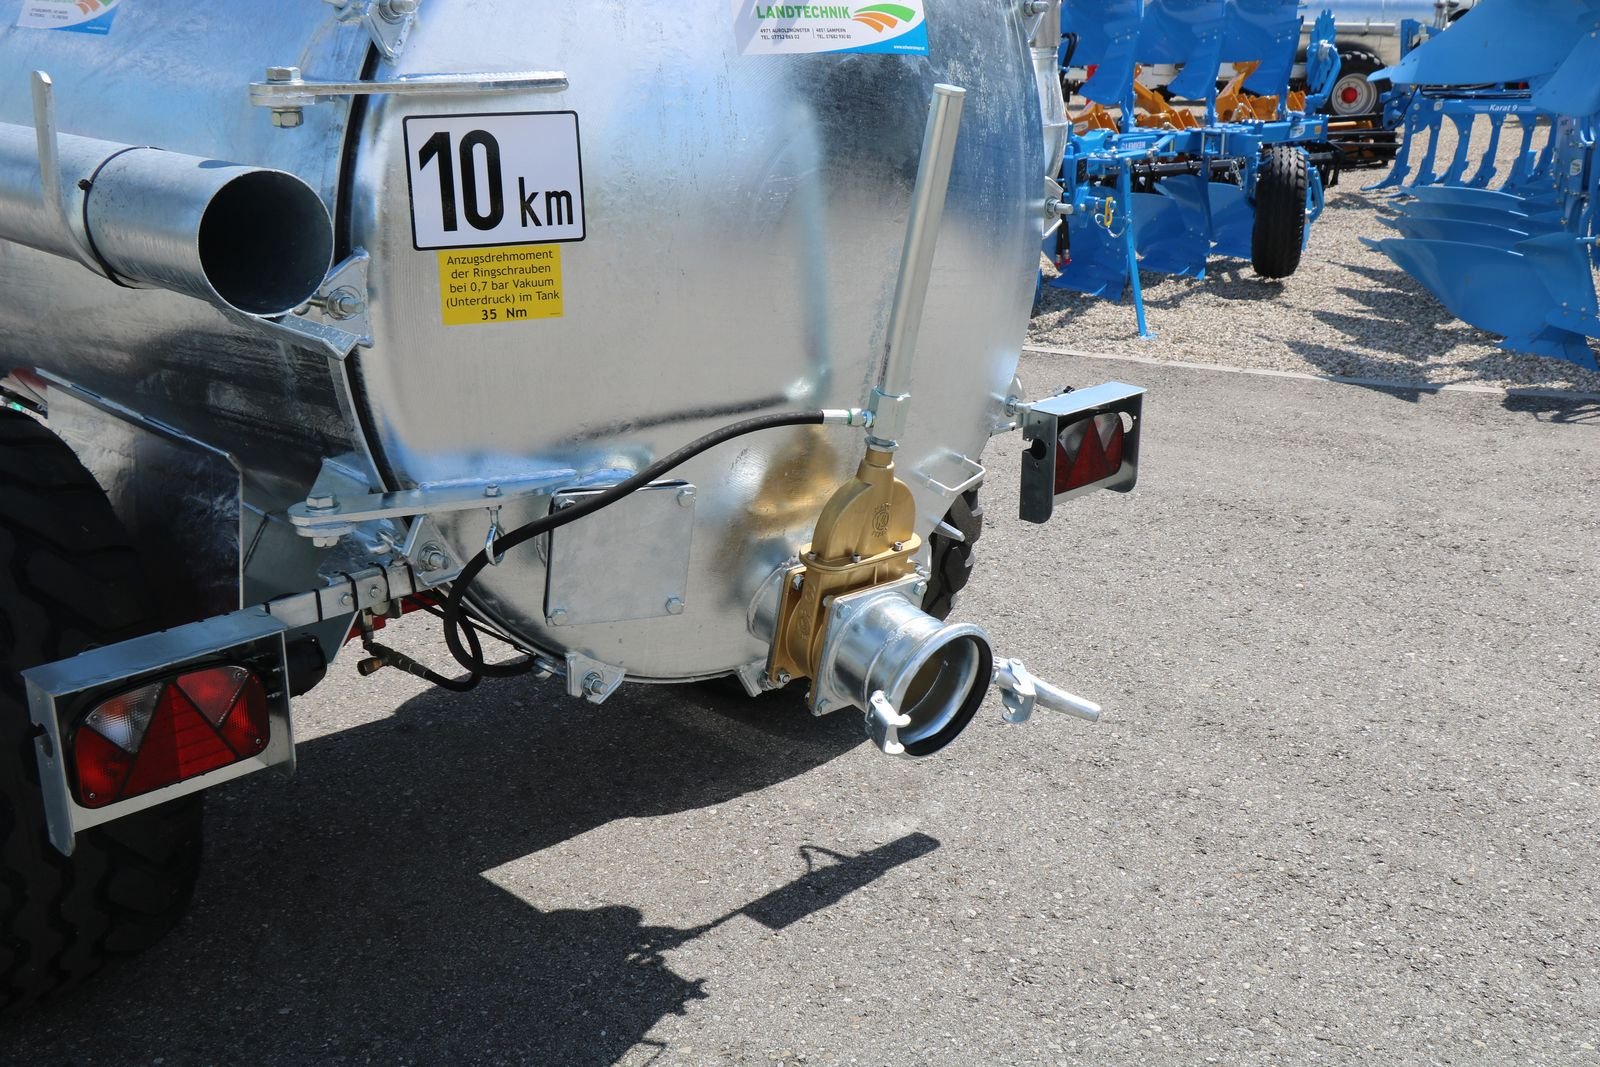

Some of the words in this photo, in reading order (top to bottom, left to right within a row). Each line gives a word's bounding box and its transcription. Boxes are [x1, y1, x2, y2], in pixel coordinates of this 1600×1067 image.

[756, 5, 850, 18] LANDTECHNIK
[418, 129, 504, 232] 10
[518, 176, 574, 227] km
[447, 250, 553, 266] Anzugsdrehmoment
[451, 270, 469, 279] der
[473, 265, 551, 278] Ringschrauben
[450, 283, 467, 293] bei
[470, 281, 488, 293] 0,7
[491, 281, 509, 290] bar
[513, 278, 554, 288] Vakuum
[446, 294, 515, 309] (Unterdruck)
[519, 293, 532, 302] im
[536, 290, 560, 300] Tank
[481, 309, 497, 320] 35
[506, 307, 527, 318] Nm
